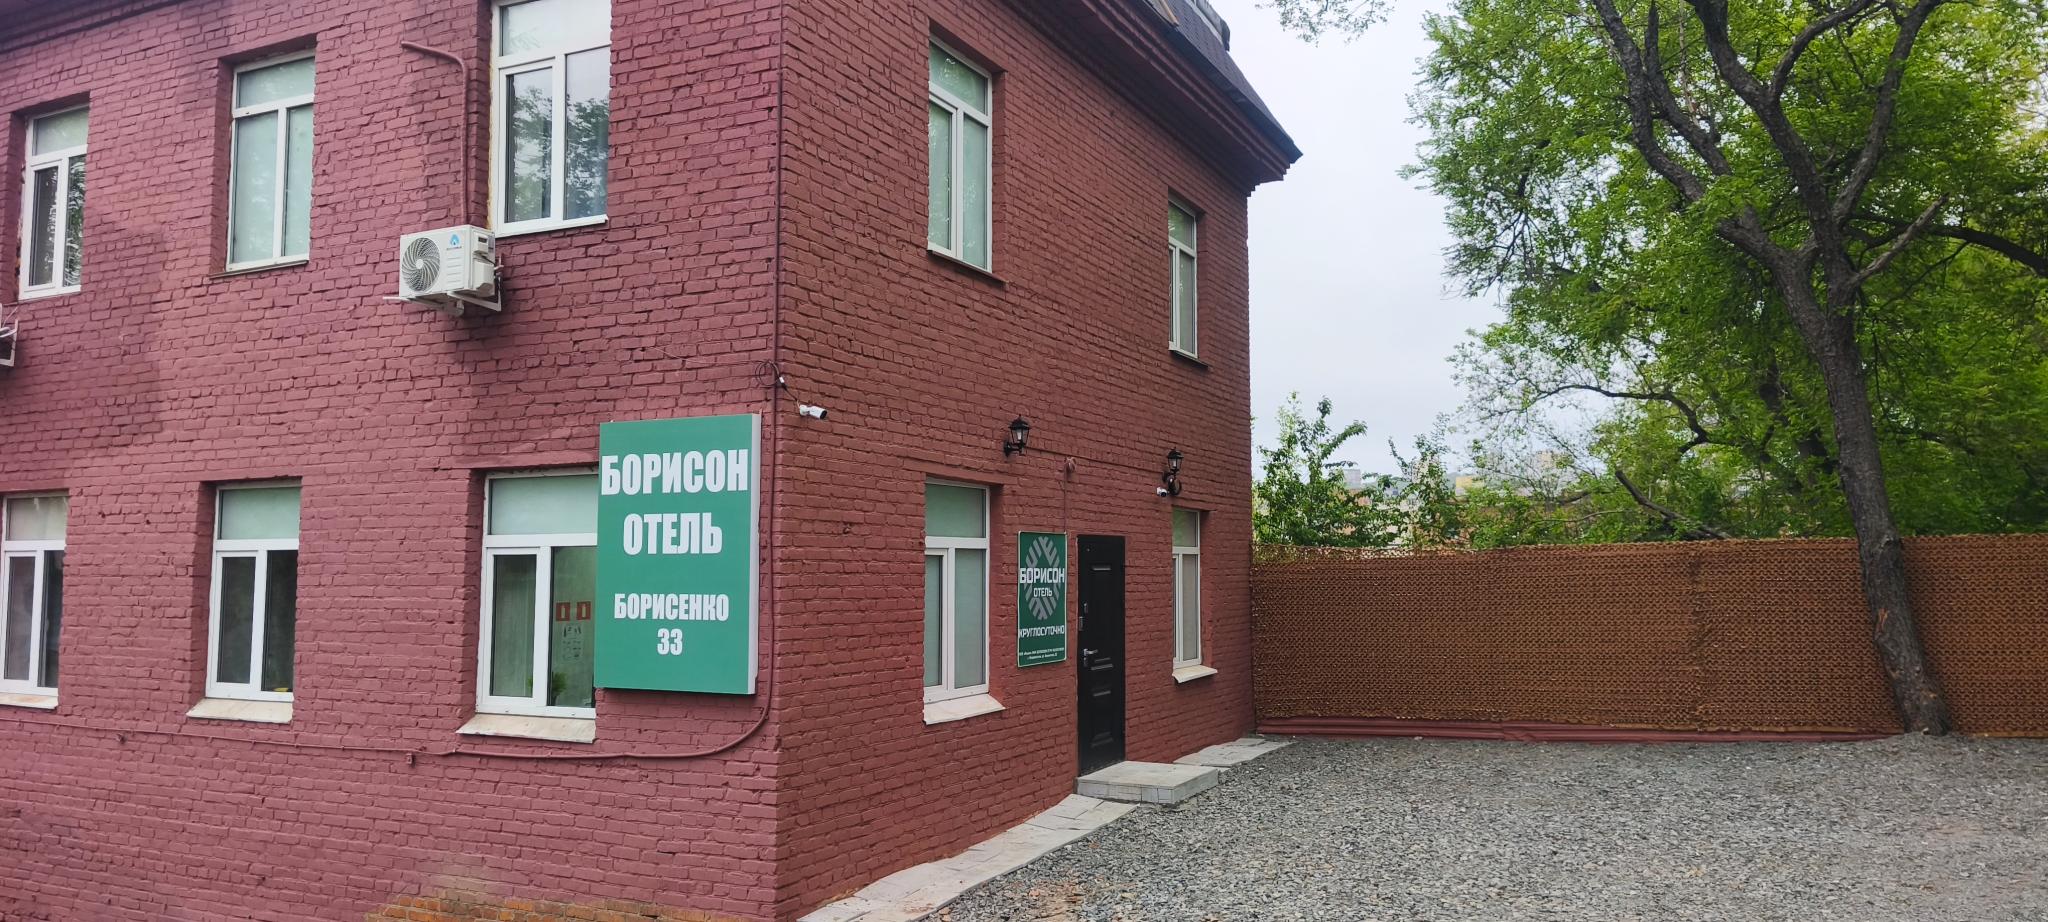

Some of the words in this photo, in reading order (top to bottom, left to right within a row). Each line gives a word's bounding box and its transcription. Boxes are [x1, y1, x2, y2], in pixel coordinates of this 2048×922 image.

[601, 449, 749, 495] БОРИСОН
[623, 512, 723, 555] ОТЕЛЬ
[1019, 567, 1065, 584] БОРИСОН
[1033, 587, 1053, 598] ОТЕЛЬ
[614, 593, 729, 621] БОРИСЕНКО
[656, 628, 683, 655] 33
[1019, 625, 1065, 639] КРУГЛОСУТОЧНО
